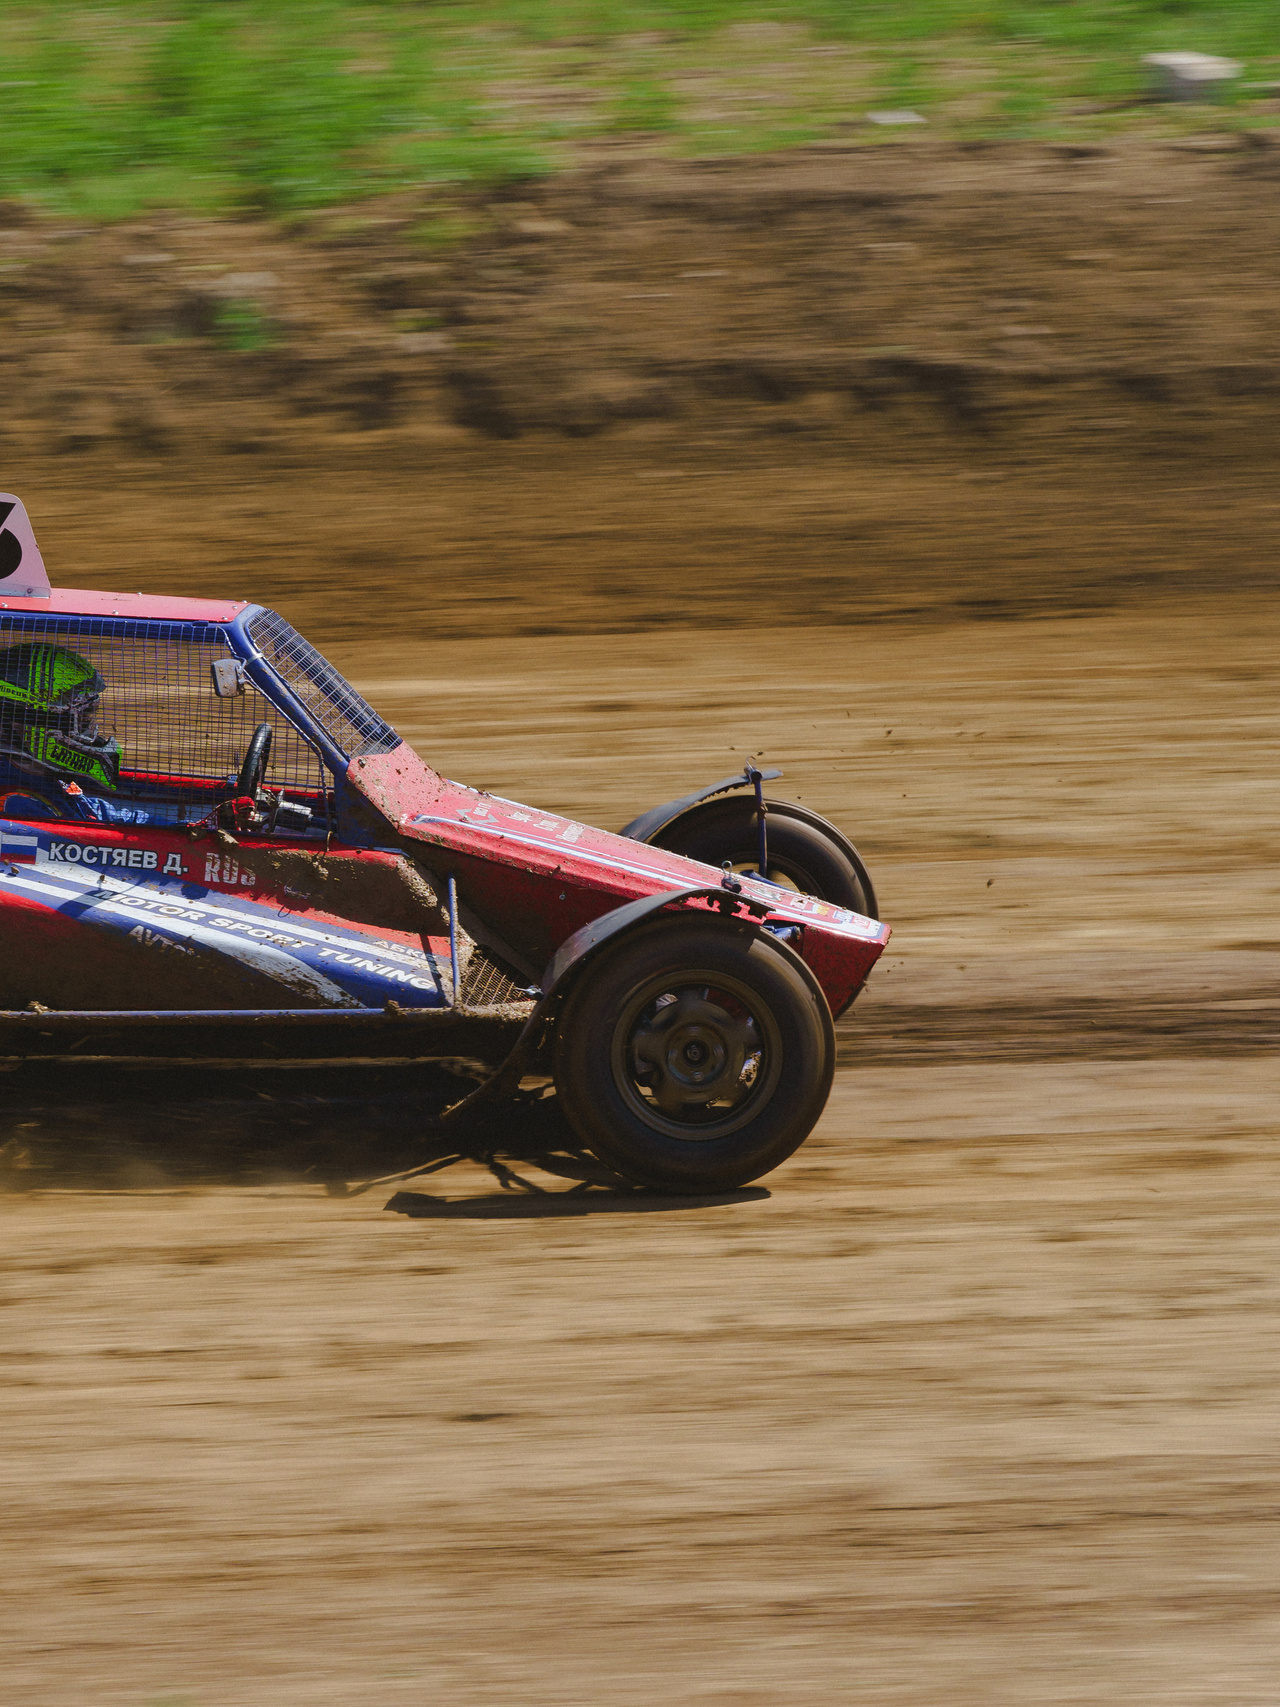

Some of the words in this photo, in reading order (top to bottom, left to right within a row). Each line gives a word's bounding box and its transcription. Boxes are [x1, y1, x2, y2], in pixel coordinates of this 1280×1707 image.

[48, 842, 159, 869] КОСТЯЕВ
[162, 853, 189, 876] Д.
[94, 890, 207, 921] MOTOR
[208, 917, 316, 949] SPORT
[318, 947, 436, 990] TUNING
